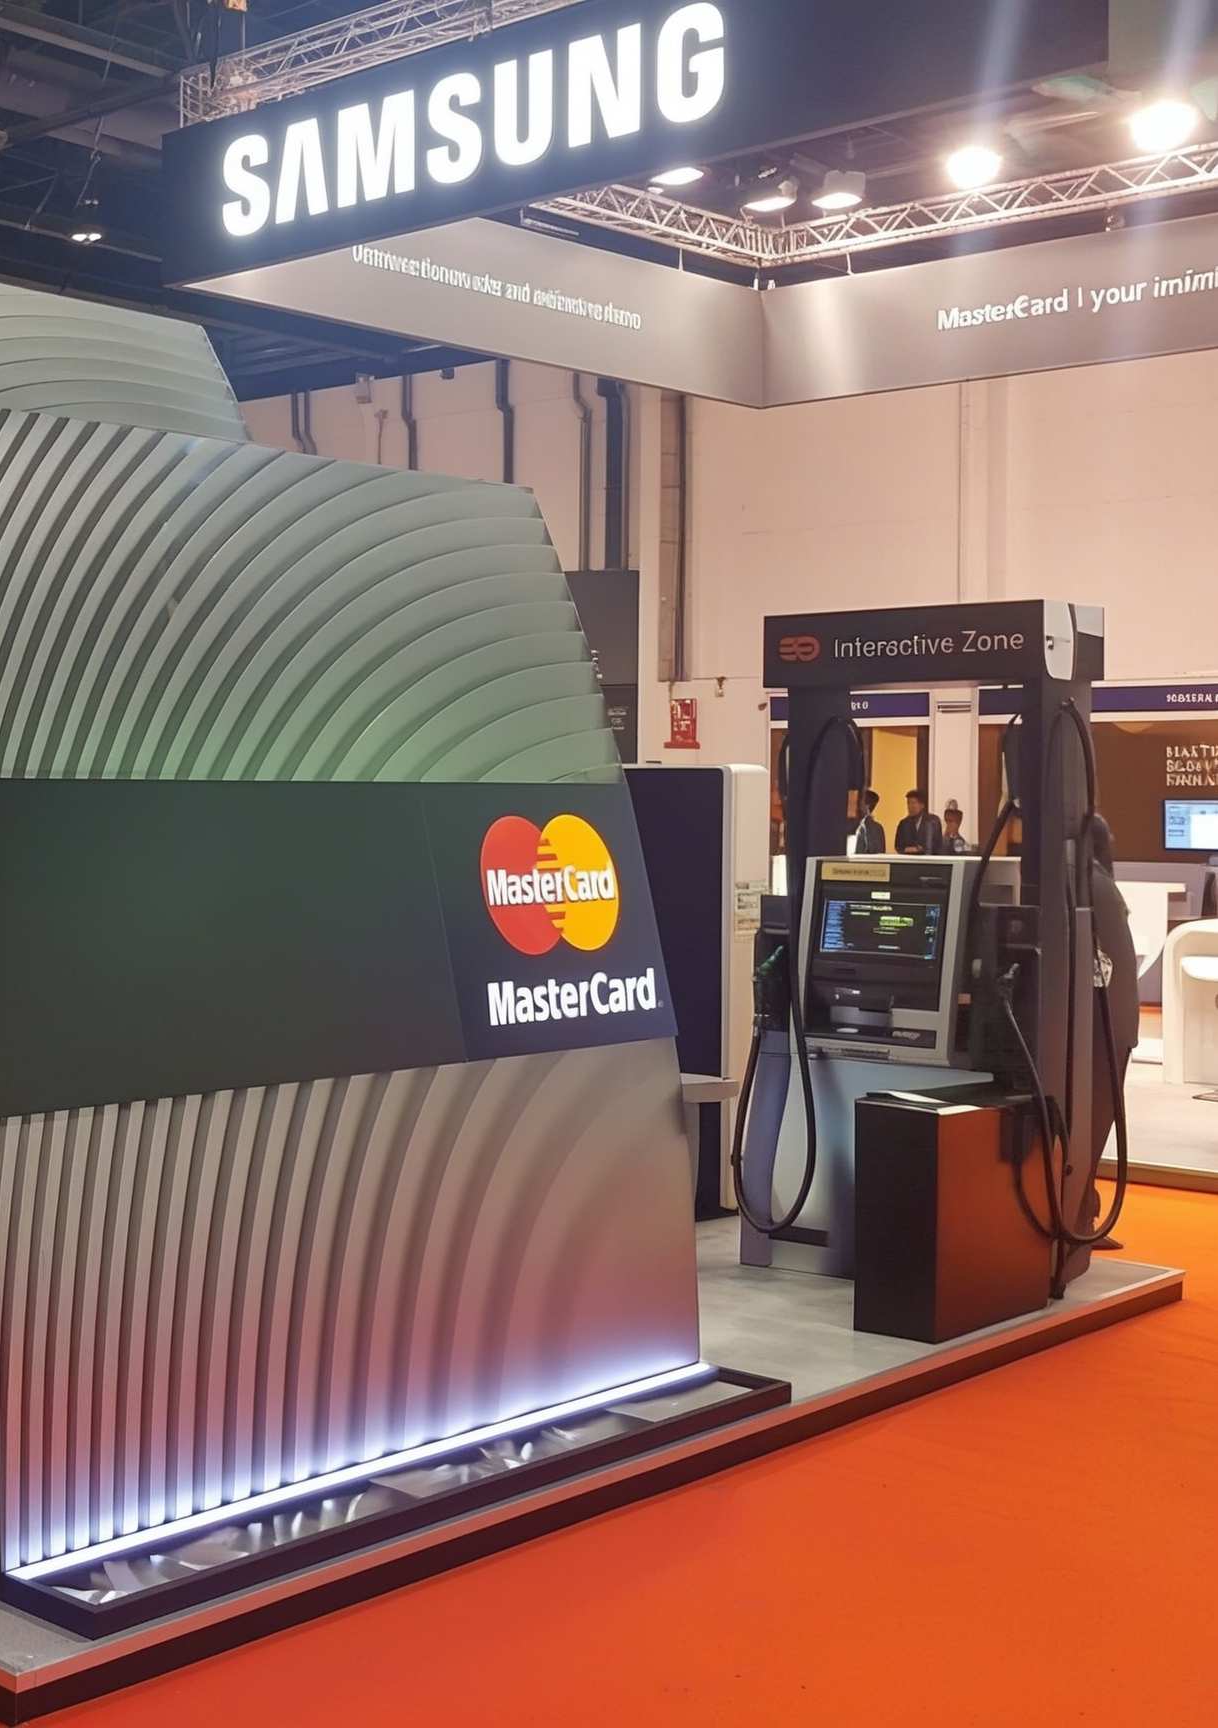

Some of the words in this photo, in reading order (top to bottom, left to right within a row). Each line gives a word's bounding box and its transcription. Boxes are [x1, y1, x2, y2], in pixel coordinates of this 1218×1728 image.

[222, 1, 725, 238] SAMSUNG
[937, 288, 1069, 331] MasterCard
[1090, 281, 1148, 313] your
[961, 629, 1025, 653] Zone
[486, 862, 615, 906] MasterCard
[487, 967, 657, 1027] MasterCard
